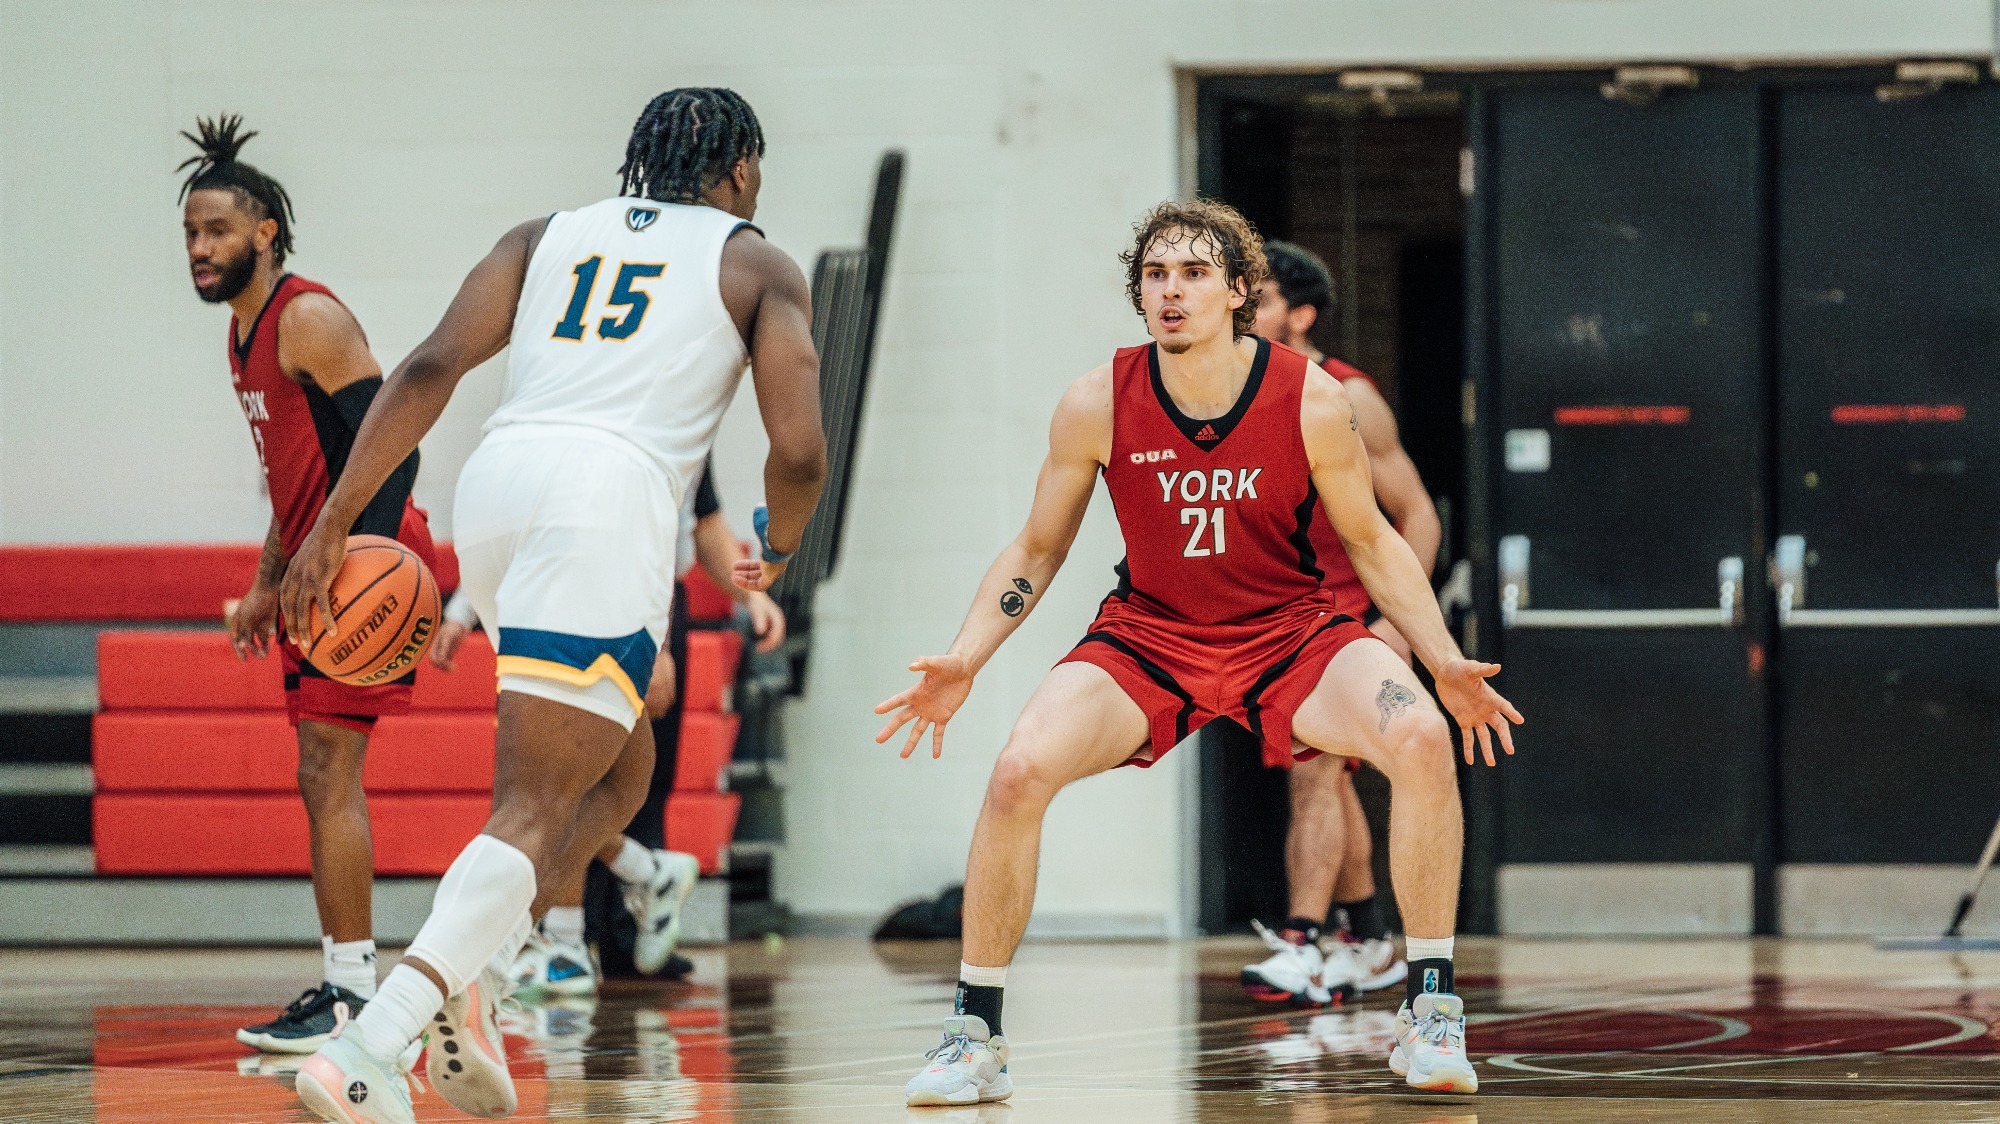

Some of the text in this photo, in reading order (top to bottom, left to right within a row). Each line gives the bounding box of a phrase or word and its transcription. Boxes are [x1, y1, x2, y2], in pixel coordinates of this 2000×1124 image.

[550, 253, 668, 343] 15
[239, 389, 270, 421] ORK
[1194, 433, 1220, 441] adidas
[1130, 449, 1178, 464] OUA
[1156, 467, 1264, 503] YORK
[1179, 506, 1226, 558] 21
[330, 594, 399, 666] EVOLUTION
